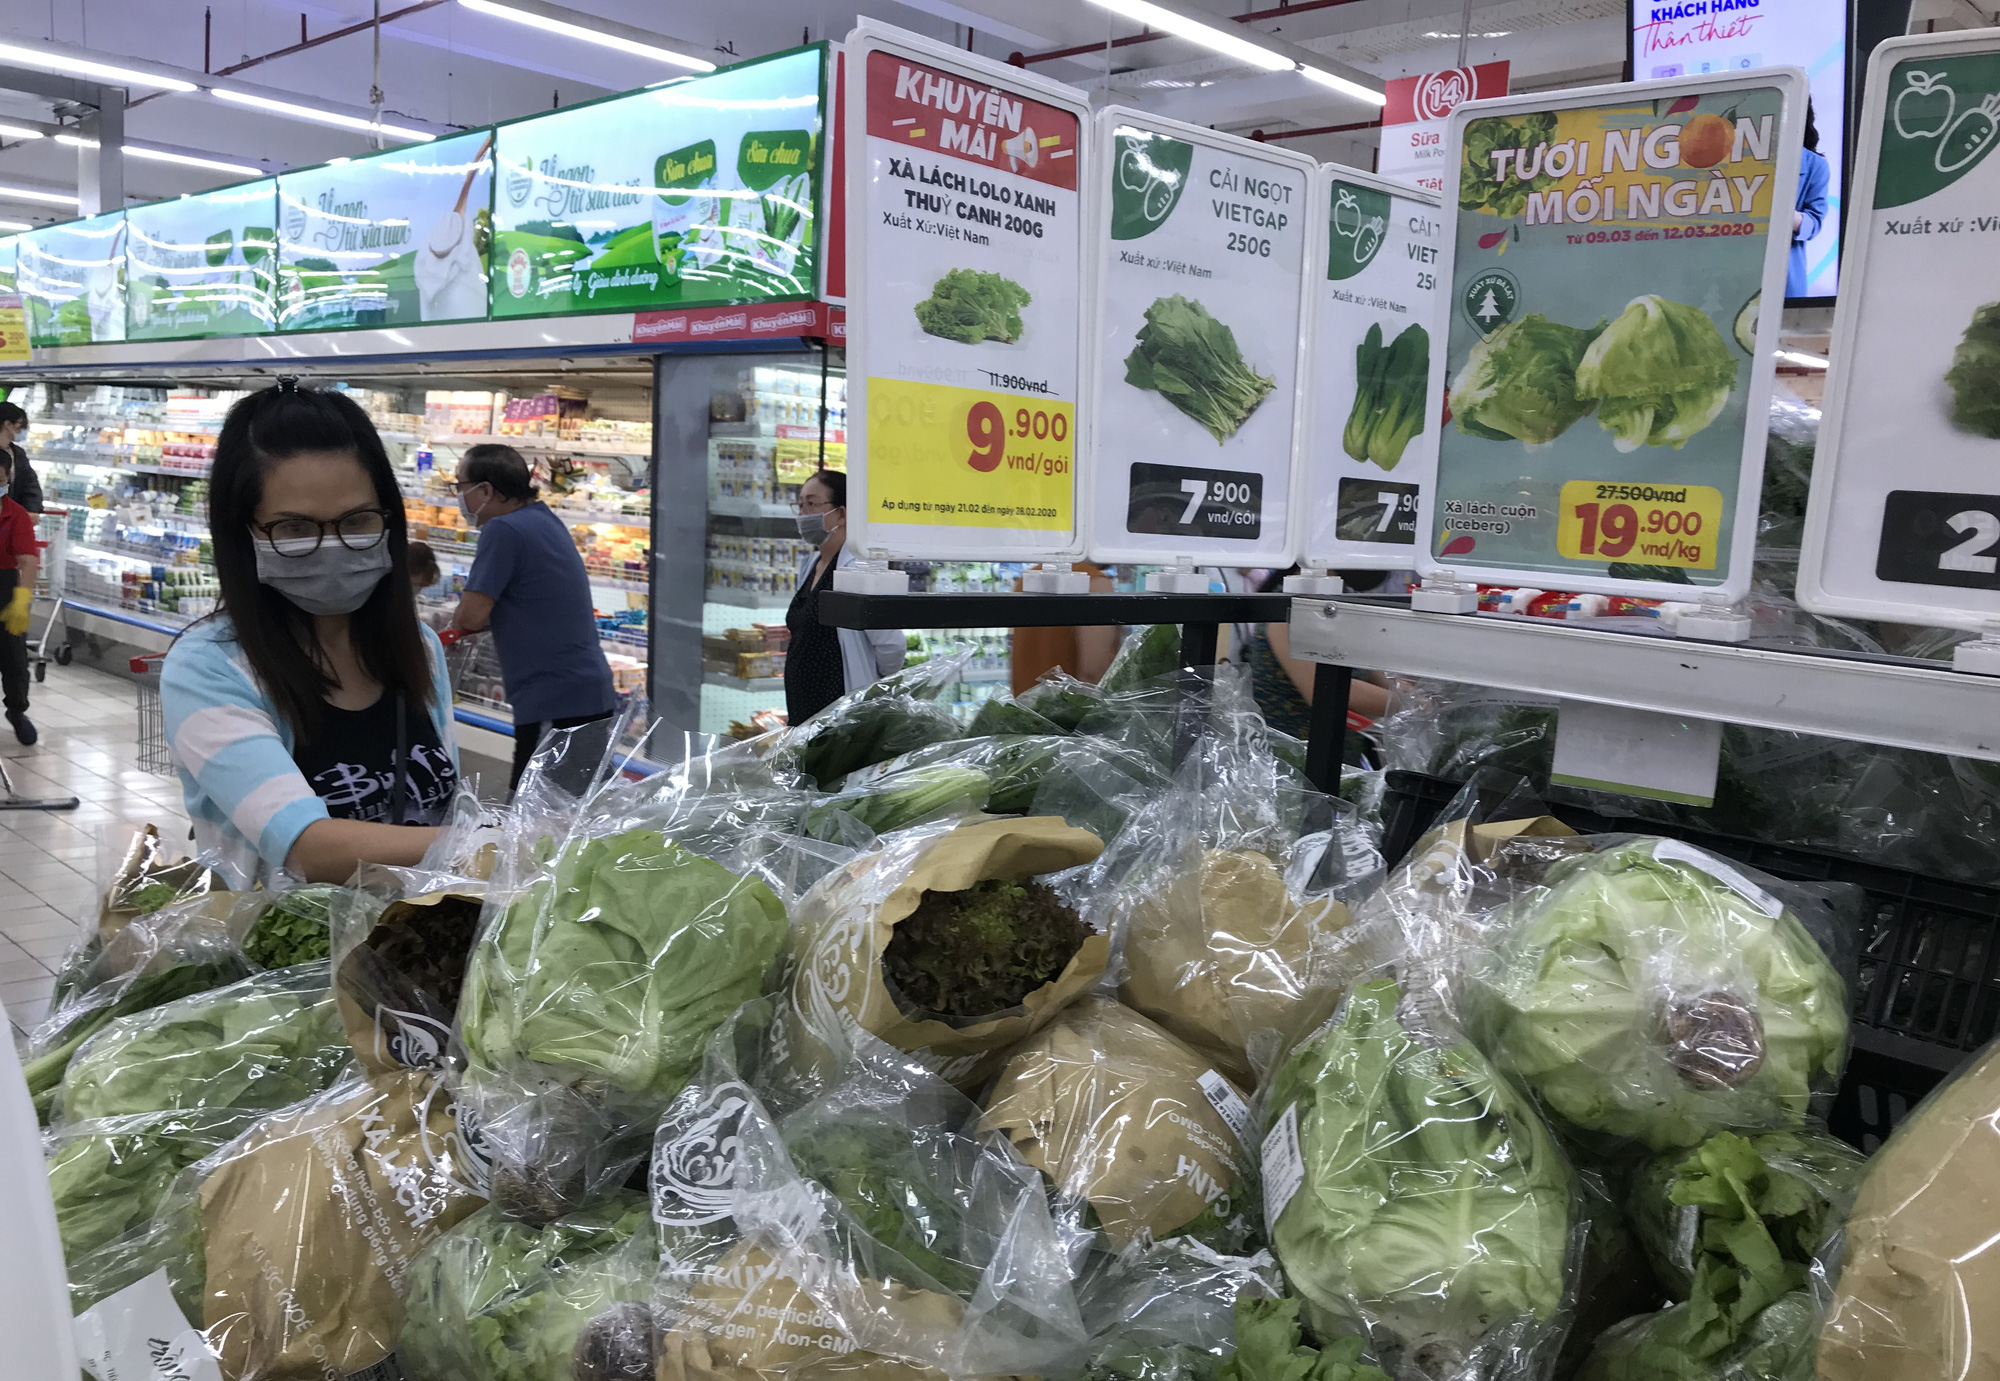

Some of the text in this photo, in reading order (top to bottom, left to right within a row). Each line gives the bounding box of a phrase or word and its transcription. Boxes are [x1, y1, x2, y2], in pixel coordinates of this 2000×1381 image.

[1429, 78, 1462, 111] 14
[939, 118, 997, 161] MÃI
[1491, 138, 1589, 182] TƯƠI
[889, 157, 1056, 217] XÀ LÁCH LOLO XANH
[1210, 167, 1292, 205] CẢI NGỌT
[1525, 171, 1769, 226] MỖI NGÀY
[956, 201, 1001, 228] CANH
[1005, 214, 1043, 239] 200G
[1212, 199, 1288, 231] VIETGAP
[1409, 216, 1431, 237] CẢI
[1884, 216, 1932, 235] Xuất
[1937, 217, 1964, 233] xứ
[883, 211, 911, 230] Xuất
[963, 229, 989, 246] Nam
[1586, 230, 1631, 244] 09.03
[1635, 228, 1659, 241] đến
[1663, 222, 1755, 240] 12.03.2020
[1226, 232, 1271, 258] 250G
[1120, 250, 1144, 266] Xuất
[1147, 257, 1161, 269] xứ
[1189, 265, 1212, 279] Nam
[1389, 301, 1407, 314] Nam
[989, 372, 1048, 393] 11.900vnd
[1007, 452, 1068, 476] vnd/gói
[1596, 484, 1687, 503] 27.500vnd
[934, 502, 956, 514] ngày
[957, 503, 979, 513] 21.02
[997, 506, 1014, 517] ngày
[1015, 506, 1057, 518] 28.02.2020
[1444, 501, 1537, 518] Xà lách cuộn
[1444, 517, 1511, 535] (Iceberg)
[1641, 539, 1701, 563] vnd/kg
[357, 1106, 395, 1150] XÀ
